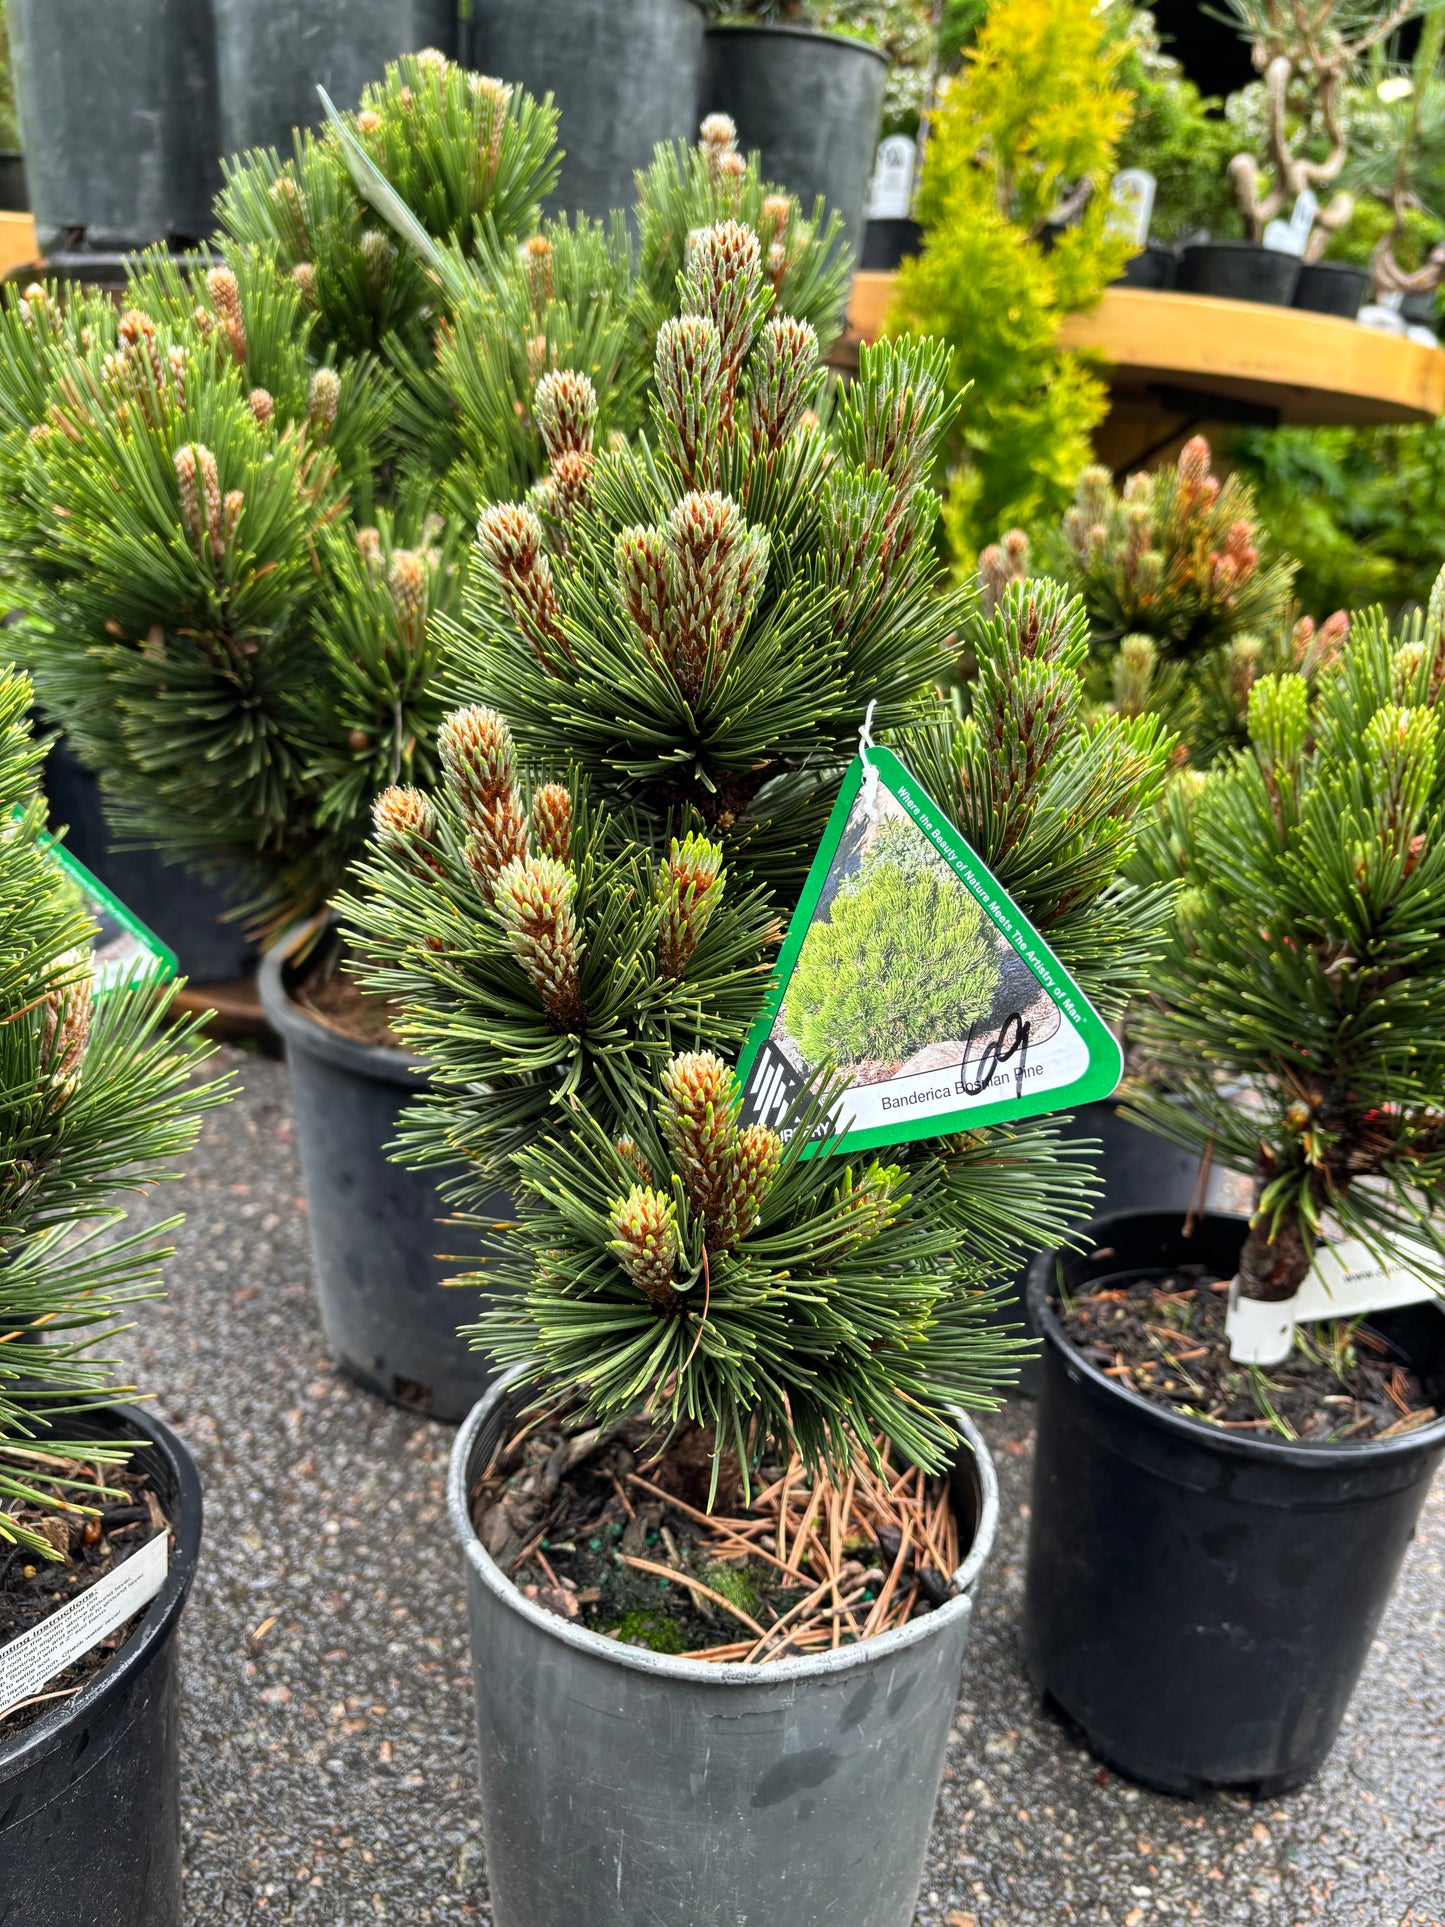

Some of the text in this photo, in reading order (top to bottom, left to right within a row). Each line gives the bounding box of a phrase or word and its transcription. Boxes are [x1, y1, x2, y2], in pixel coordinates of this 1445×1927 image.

[897, 786, 920, 815] Where
[919, 813, 933, 831] the
[931, 829, 958, 861] Beauty
[955, 861, 968, 872] of
[964, 870, 990, 903] Nature
[988, 901, 1013, 932] Meets
[1011, 929, 1028, 951] The
[1025, 950, 1056, 987] Artistry
[1054, 988, 1067, 1000] of
[881, 1087, 951, 1110] Banderica
[1013, 1064, 1044, 1082] Pine
[6, 1656, 36, 1678] planting
[37, 1646, 50, 1656] mix
[52, 1634, 65, 1646] and
[95, 1606, 102, 1614] to
[104, 1586, 127, 1608] ground
[7, 1657, 22, 1669] root
[24, 1646, 38, 1658] ball
[40, 1628, 64, 1648] slightly
[66, 1611, 88, 1628] above
[90, 1591, 114, 1612] ground
[8, 1646, 28, 1661] times
[30, 1637, 42, 1647] the
[44, 1622, 63, 1637] width
[73, 1606, 85, 1616] the
[33, 1589, 98, 1637] Instructions:
[7, 1682, 26, 1697] layer
[27, 1675, 35, 1683] of
[61, 1640, 84, 1658] Check
[85, 1624, 104, 1640] water
[43, 1645, 58, 1658] with
[75, 1623, 88, 1634] soil
[13, 1685, 29, 1699] until
[15, 1669, 35, 1684] settle
